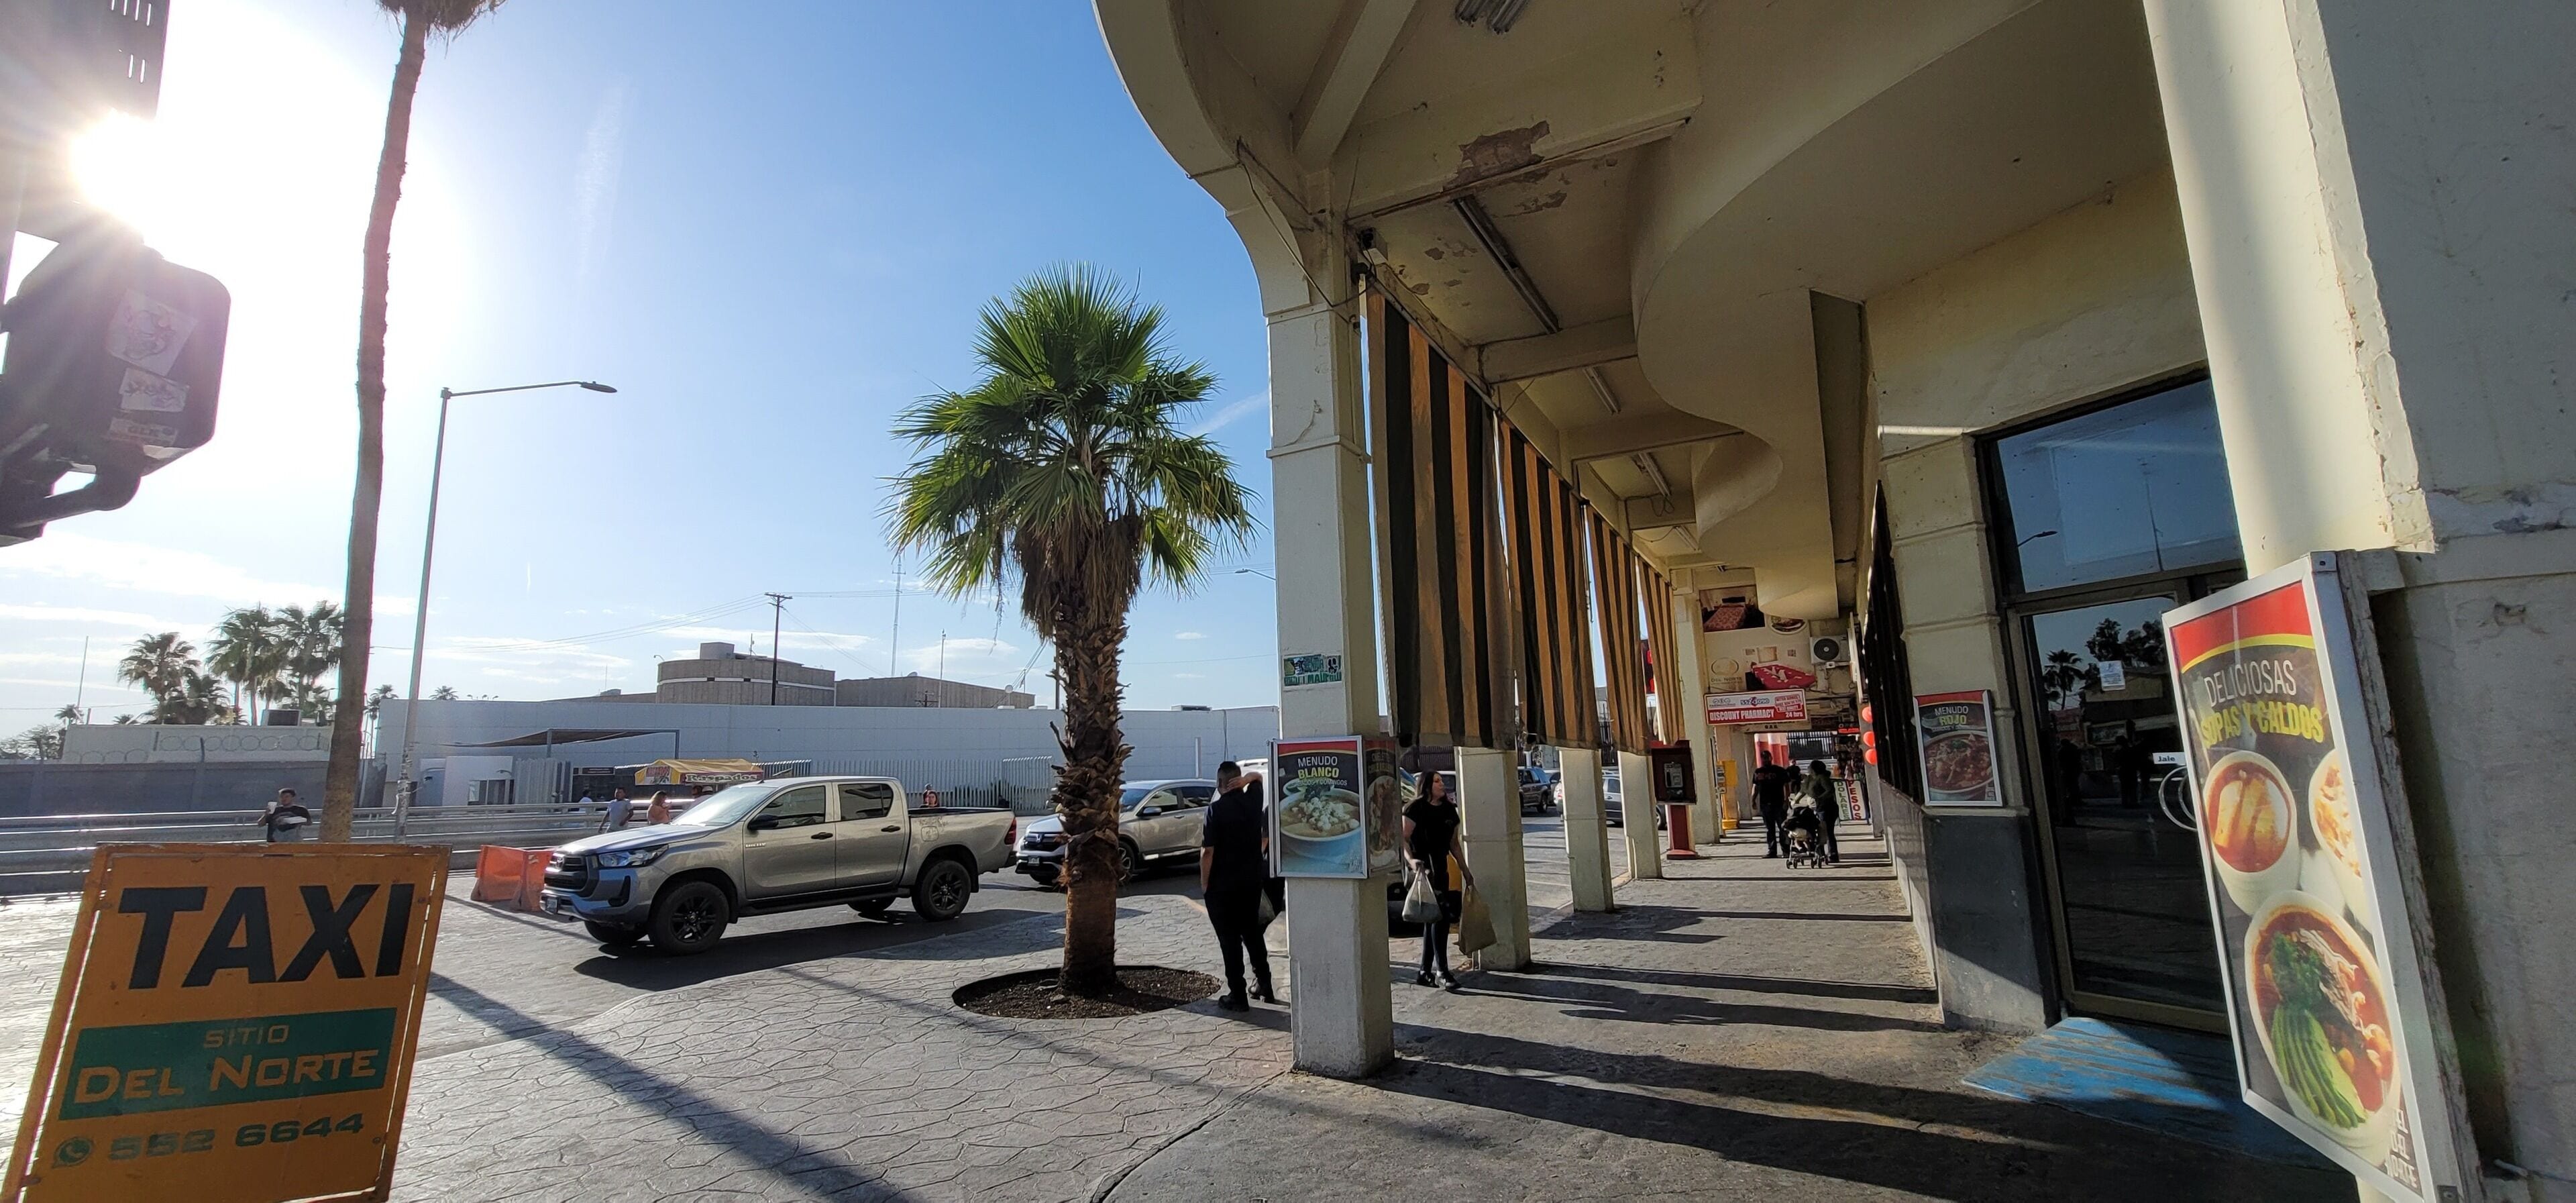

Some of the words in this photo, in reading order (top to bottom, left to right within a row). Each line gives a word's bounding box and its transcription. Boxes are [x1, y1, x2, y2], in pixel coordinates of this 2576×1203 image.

[2204, 660, 2296, 707] DELICIOSAS
[1710, 711, 1740, 721] DISCOUNT
[1741, 709, 1774, 720] PHARMACY
[1935, 706, 1969, 715] MENUDO
[1939, 715, 1967, 726] ROJO
[2200, 706, 2241, 749] SOPAS
[2242, 700, 2251, 723] Y
[2257, 700, 2324, 743] CALDOS
[1297, 755, 1338, 768] MENUDO
[1297, 767, 1340, 780] BLANCO
[686, 773, 757, 783] Raspados
[1837, 782, 1851, 821] DOLARES
[1848, 780, 1862, 821] PESOS
[118, 884, 415, 990] TAXI
[203, 1025, 289, 1049] SITIO
[73, 1066, 184, 1104] DEL
[210, 1049, 378, 1092] NORTE
[108, 1129, 215, 1161] 552
[235, 1113, 364, 1148] 6644
